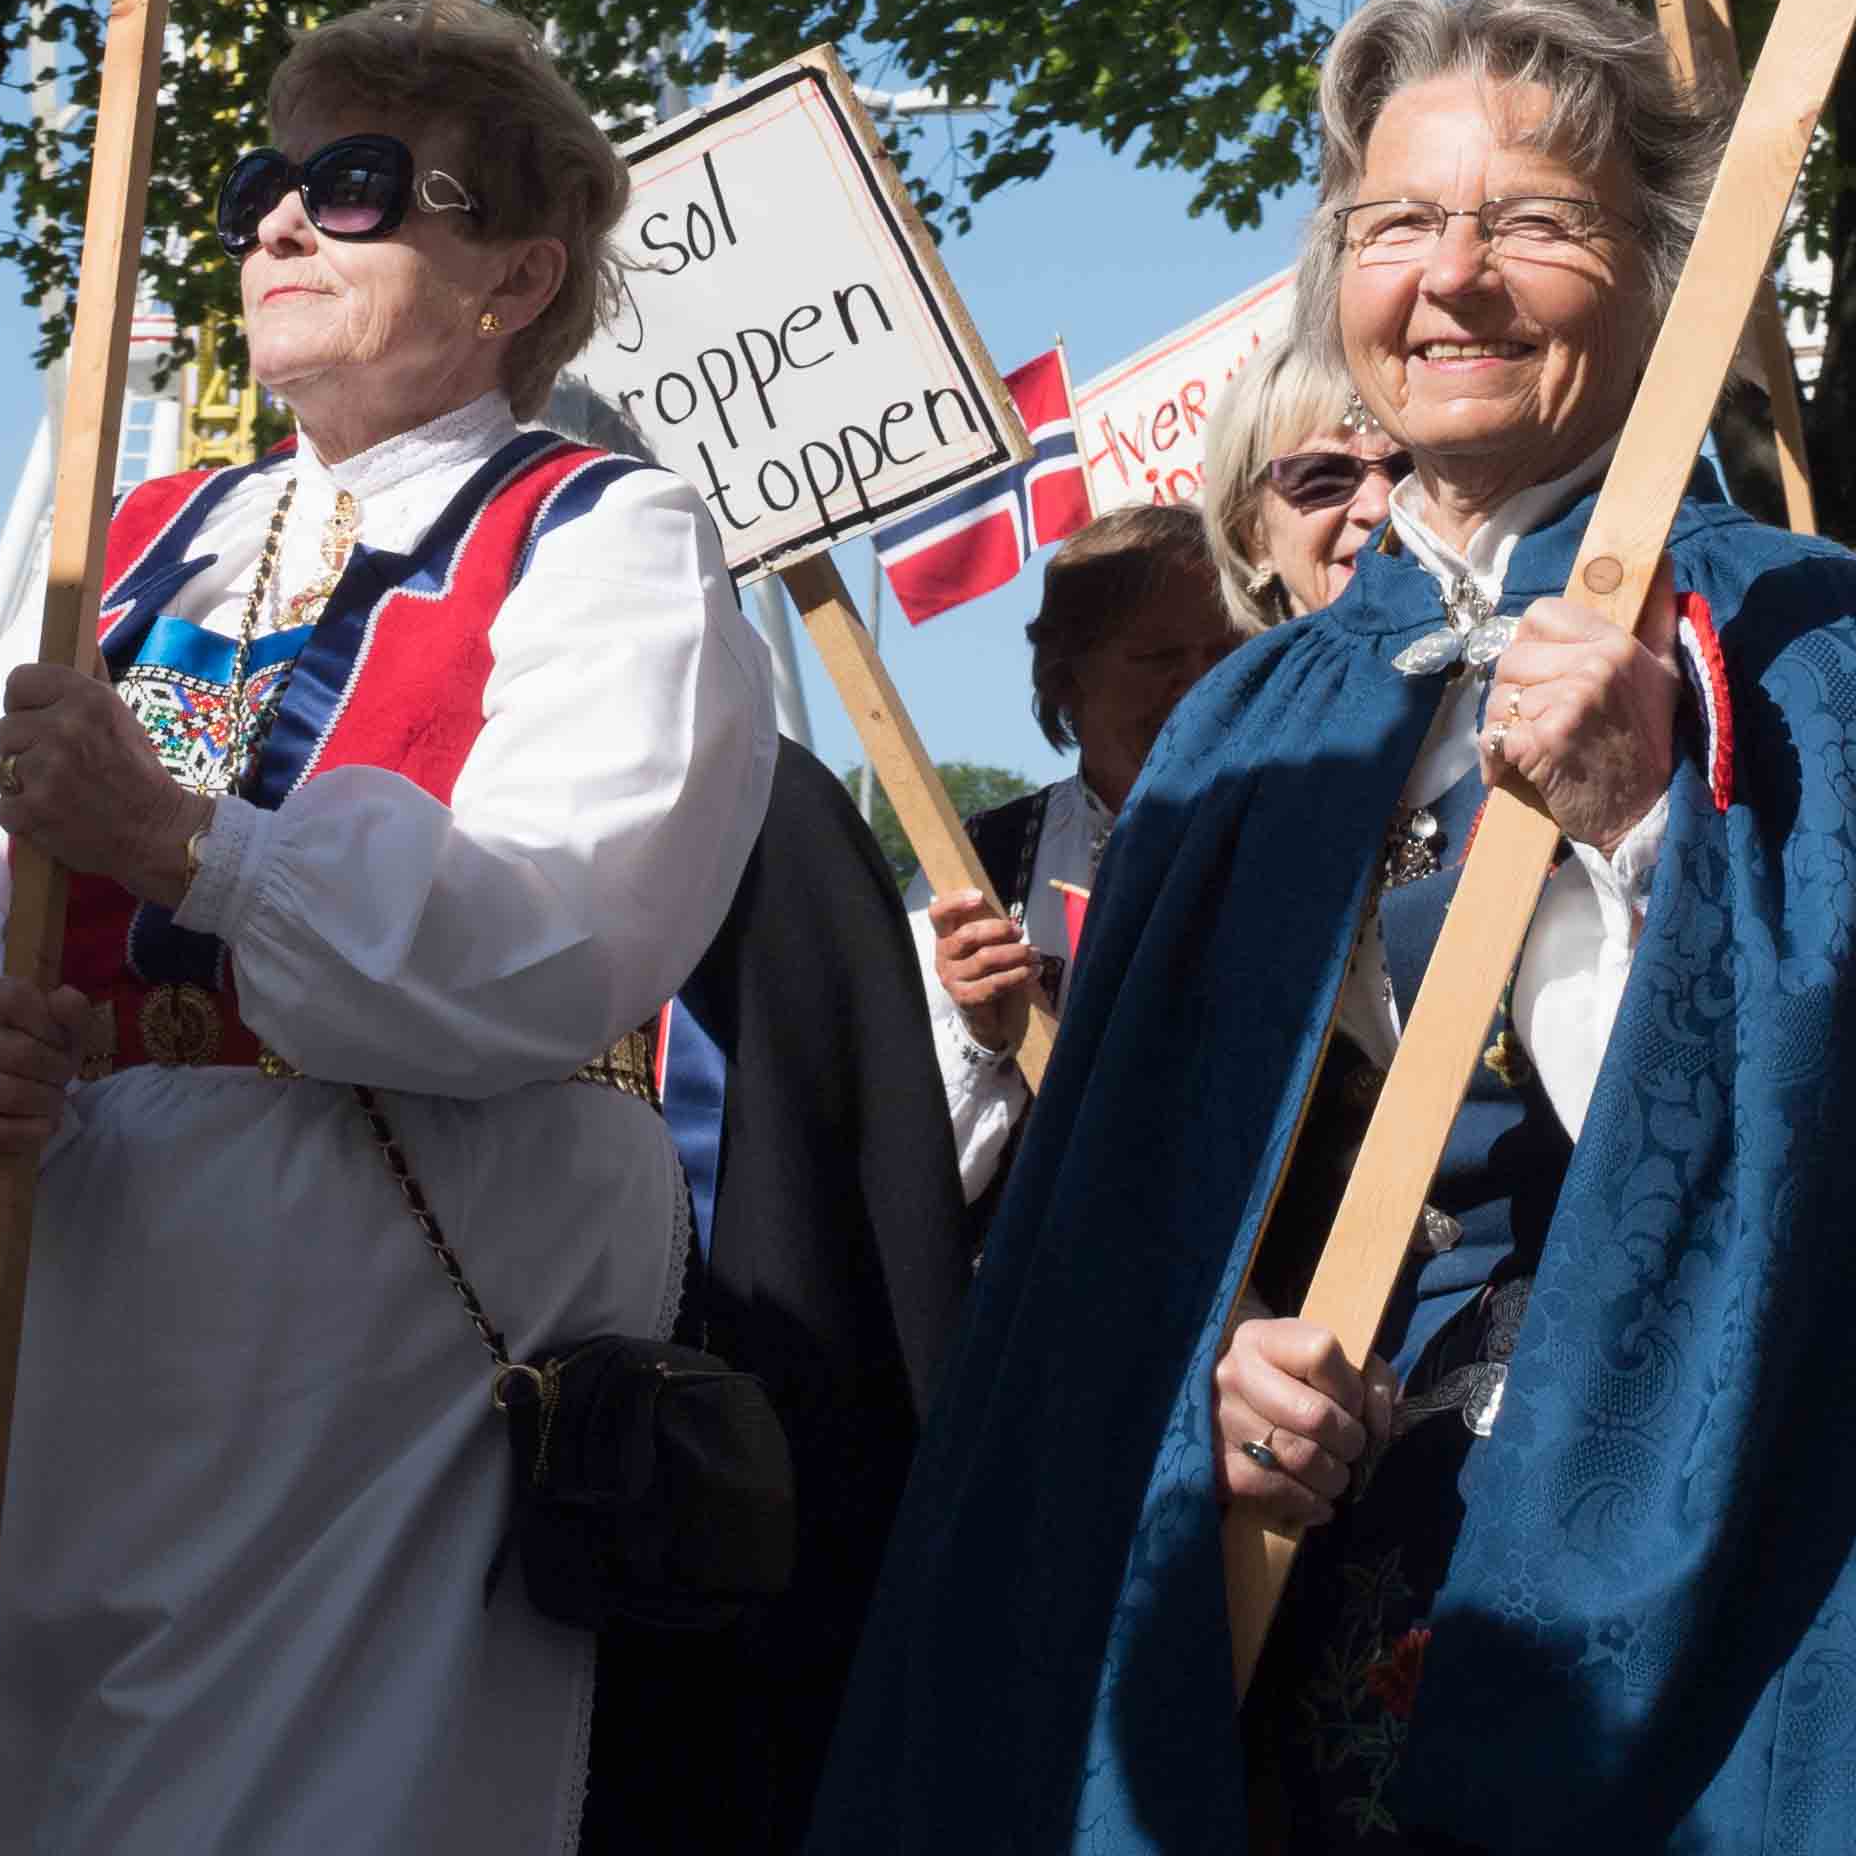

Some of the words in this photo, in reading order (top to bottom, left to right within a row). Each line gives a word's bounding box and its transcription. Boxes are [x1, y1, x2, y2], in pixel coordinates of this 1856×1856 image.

[640, 151, 737, 276] sol
[616, 282, 894, 449] roppen
[696, 388, 980, 540] toppen
